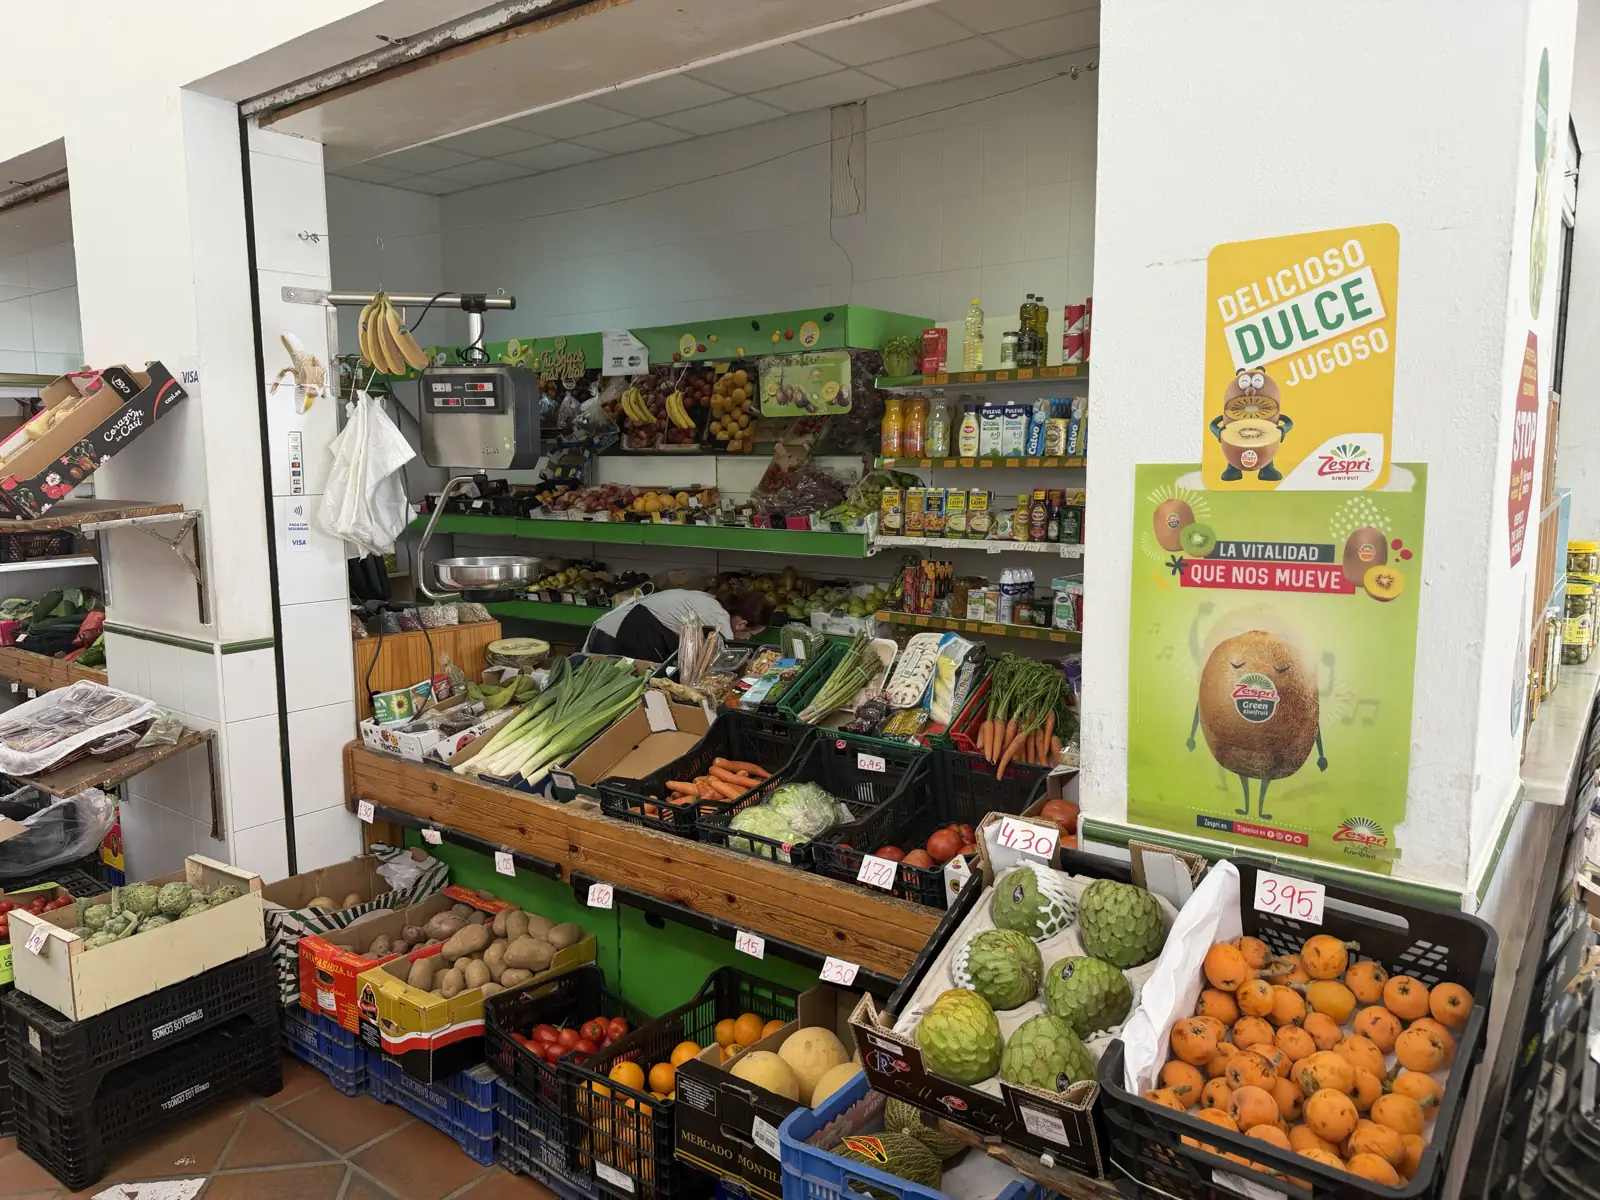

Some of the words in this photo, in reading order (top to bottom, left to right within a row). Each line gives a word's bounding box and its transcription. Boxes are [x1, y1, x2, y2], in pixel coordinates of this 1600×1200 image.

[1217, 239, 1365, 322] DELICIOSO
[1235, 277, 1373, 364] DULCE
[1286, 328, 1389, 386] JUGOSO
[181, 371, 199, 383] VISA
[1029, 426, 1040, 455] Calvo
[1069, 424, 1078, 454] Calvo
[1513, 410, 1537, 462] STOP
[1317, 456, 1373, 477] Zespri
[1219, 543, 1236, 557] LA
[1242, 544, 1319, 561] VITALIDAD
[1190, 564, 1225, 583] QUE
[1231, 566, 1269, 585] NOS
[1275, 568, 1341, 589] MUEVE
[1233, 684, 1278, 700] Zespri
[1243, 701, 1268, 710] Green
[859, 759, 882, 770] 0,95
[1001, 821, 1053, 855] 4,30
[1332, 825, 1388, 849] Zespri
[1260, 879, 1318, 917] 3,95
[174, 1020, 185, 1031] LOS
[185, 1089, 195, 1100] LOS
[681, 1129, 733, 1160] MERCADO
[738, 1153, 782, 1184] MONTIL
